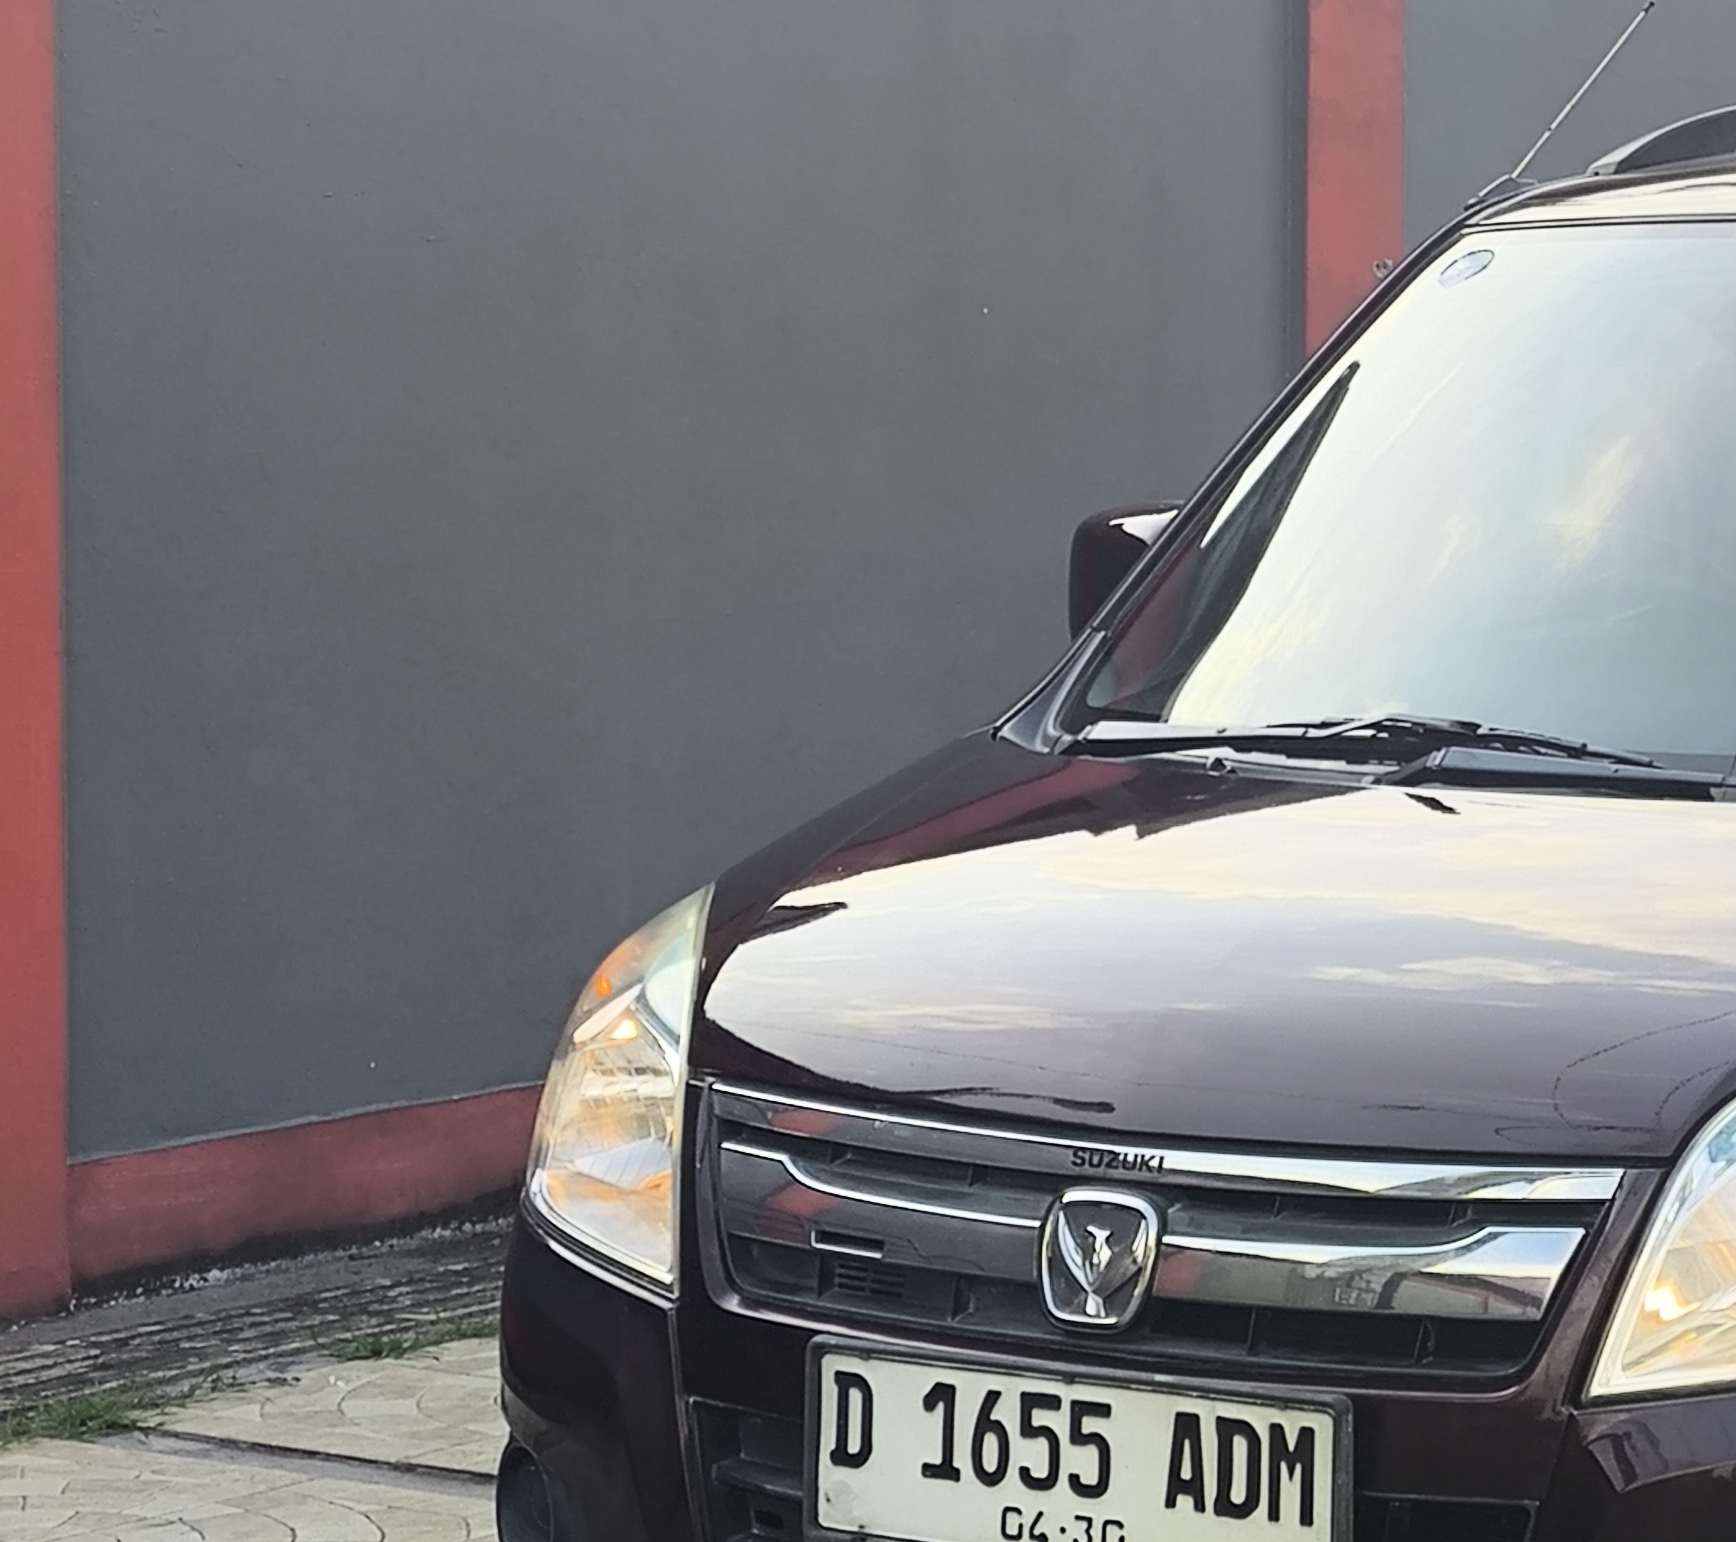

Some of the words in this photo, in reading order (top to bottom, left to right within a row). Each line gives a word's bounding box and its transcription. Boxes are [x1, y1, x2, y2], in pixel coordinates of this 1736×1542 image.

[1071, 1149, 1165, 1174] SUZUKI
[829, 1370, 873, 1468] D
[921, 1381, 1112, 1499] 1655
[1164, 1411, 1316, 1527] ADM
